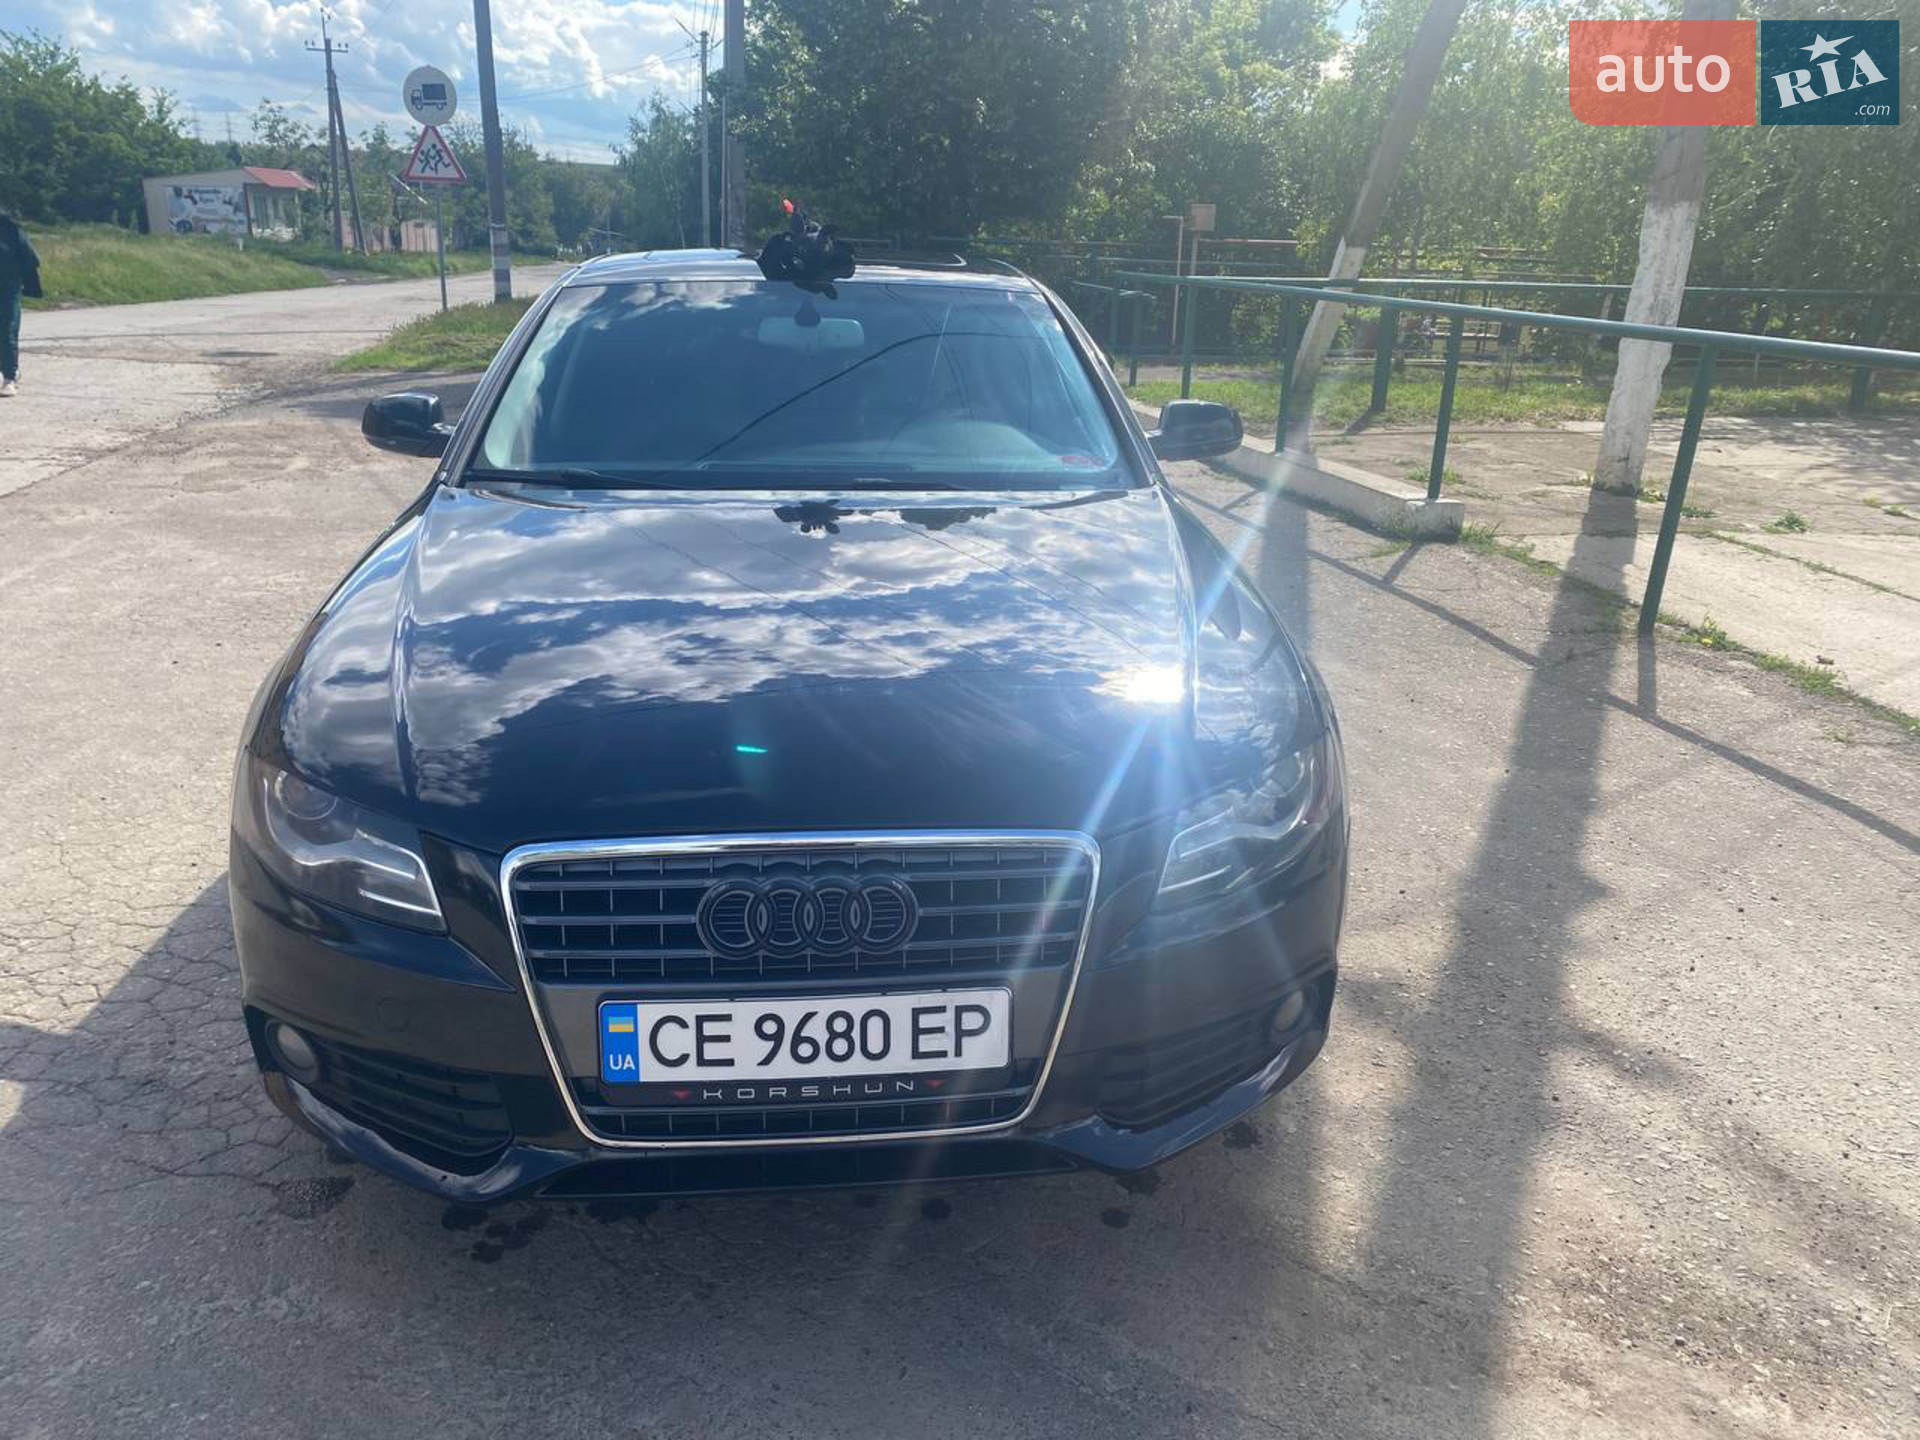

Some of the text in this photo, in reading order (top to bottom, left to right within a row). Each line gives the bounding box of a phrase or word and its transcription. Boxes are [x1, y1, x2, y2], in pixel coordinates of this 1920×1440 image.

[648, 1004, 992, 1068] CE 9680 EP
[609, 1053, 635, 1071] UA
[703, 1080, 915, 1101] KORSHUN
